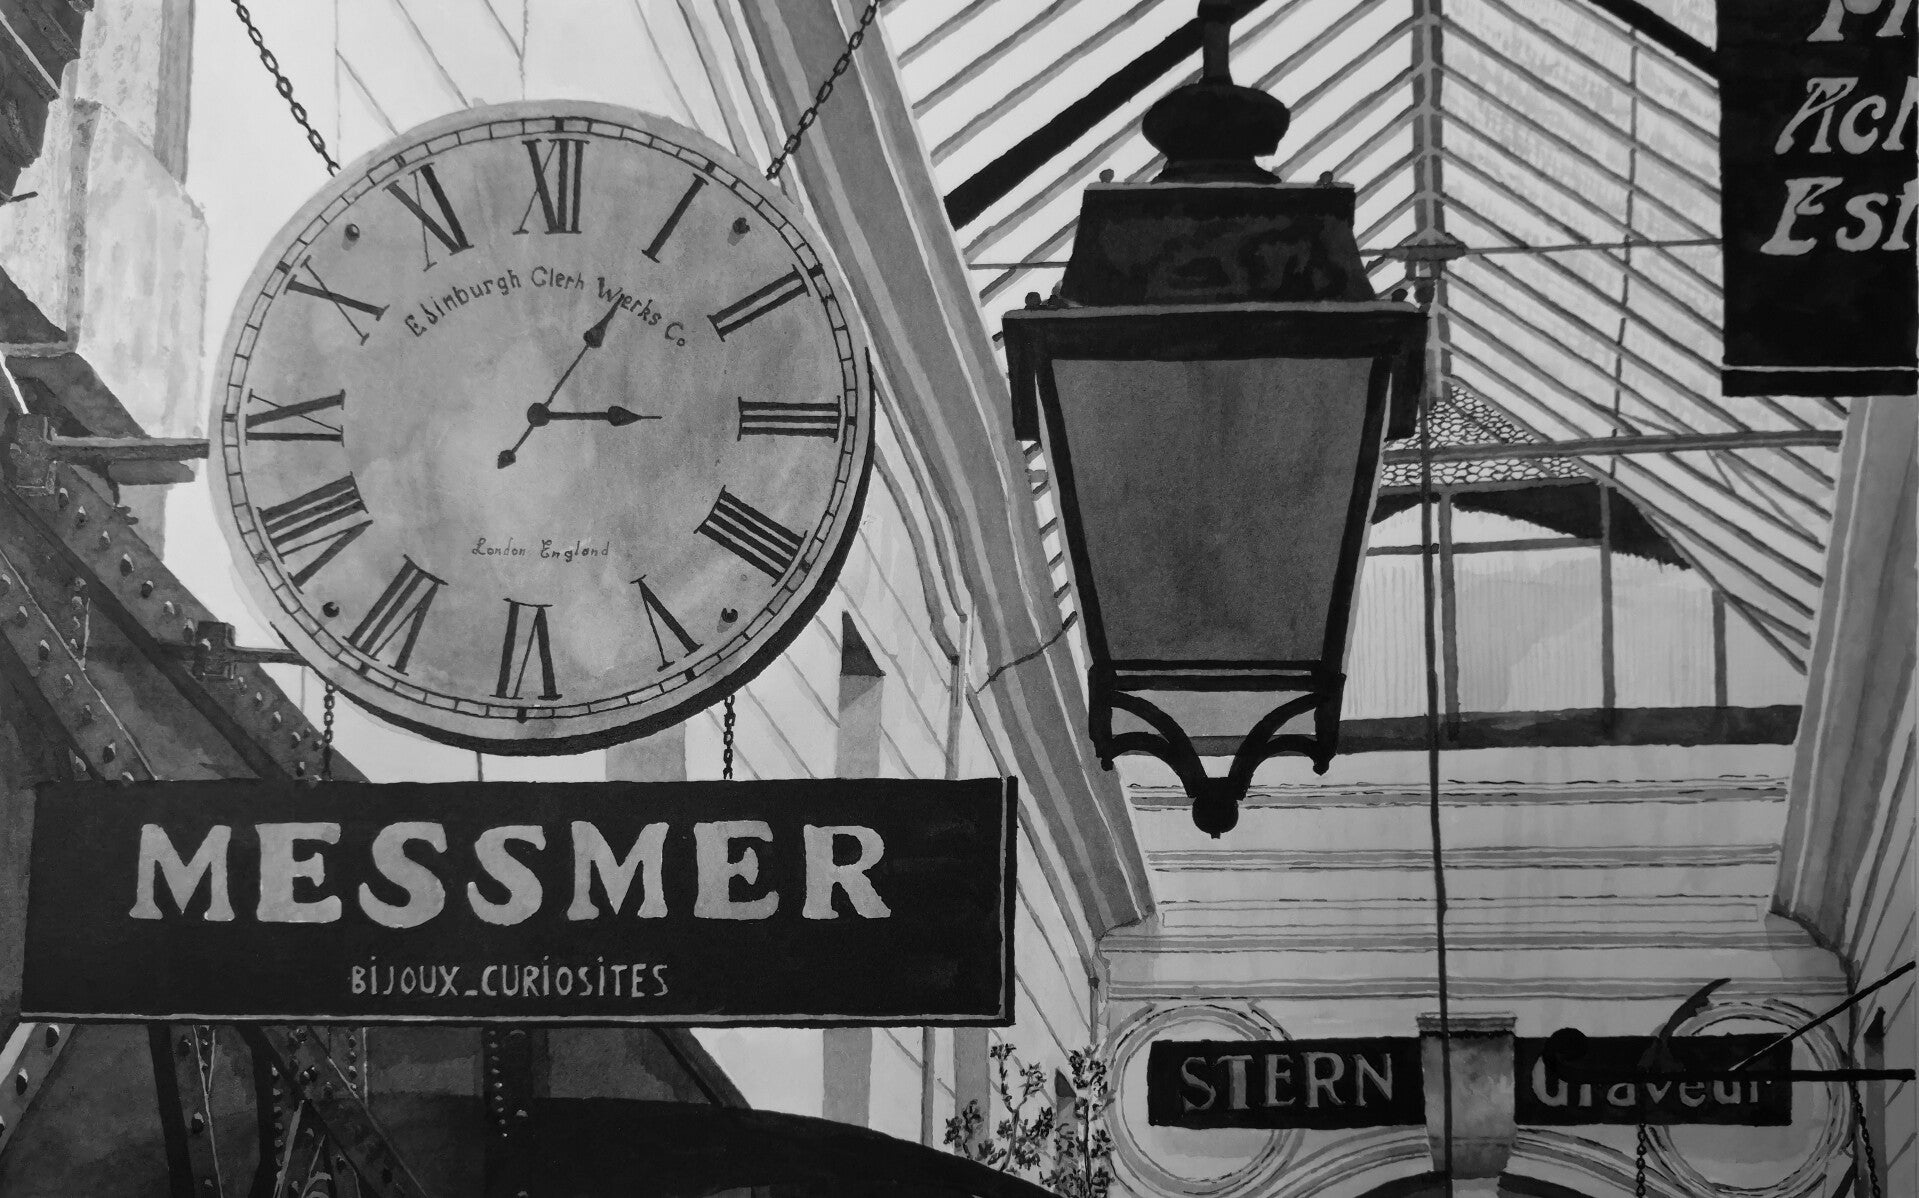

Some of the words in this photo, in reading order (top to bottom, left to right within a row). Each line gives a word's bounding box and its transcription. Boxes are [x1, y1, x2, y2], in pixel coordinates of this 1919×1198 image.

[512, 138, 591, 235] XII
[664, 321, 686, 348] Co
[471, 537, 526, 556] London
[540, 539, 610, 563] England
[129, 819, 892, 929] MESSMER
[1180, 1051, 1394, 1113] STERN
